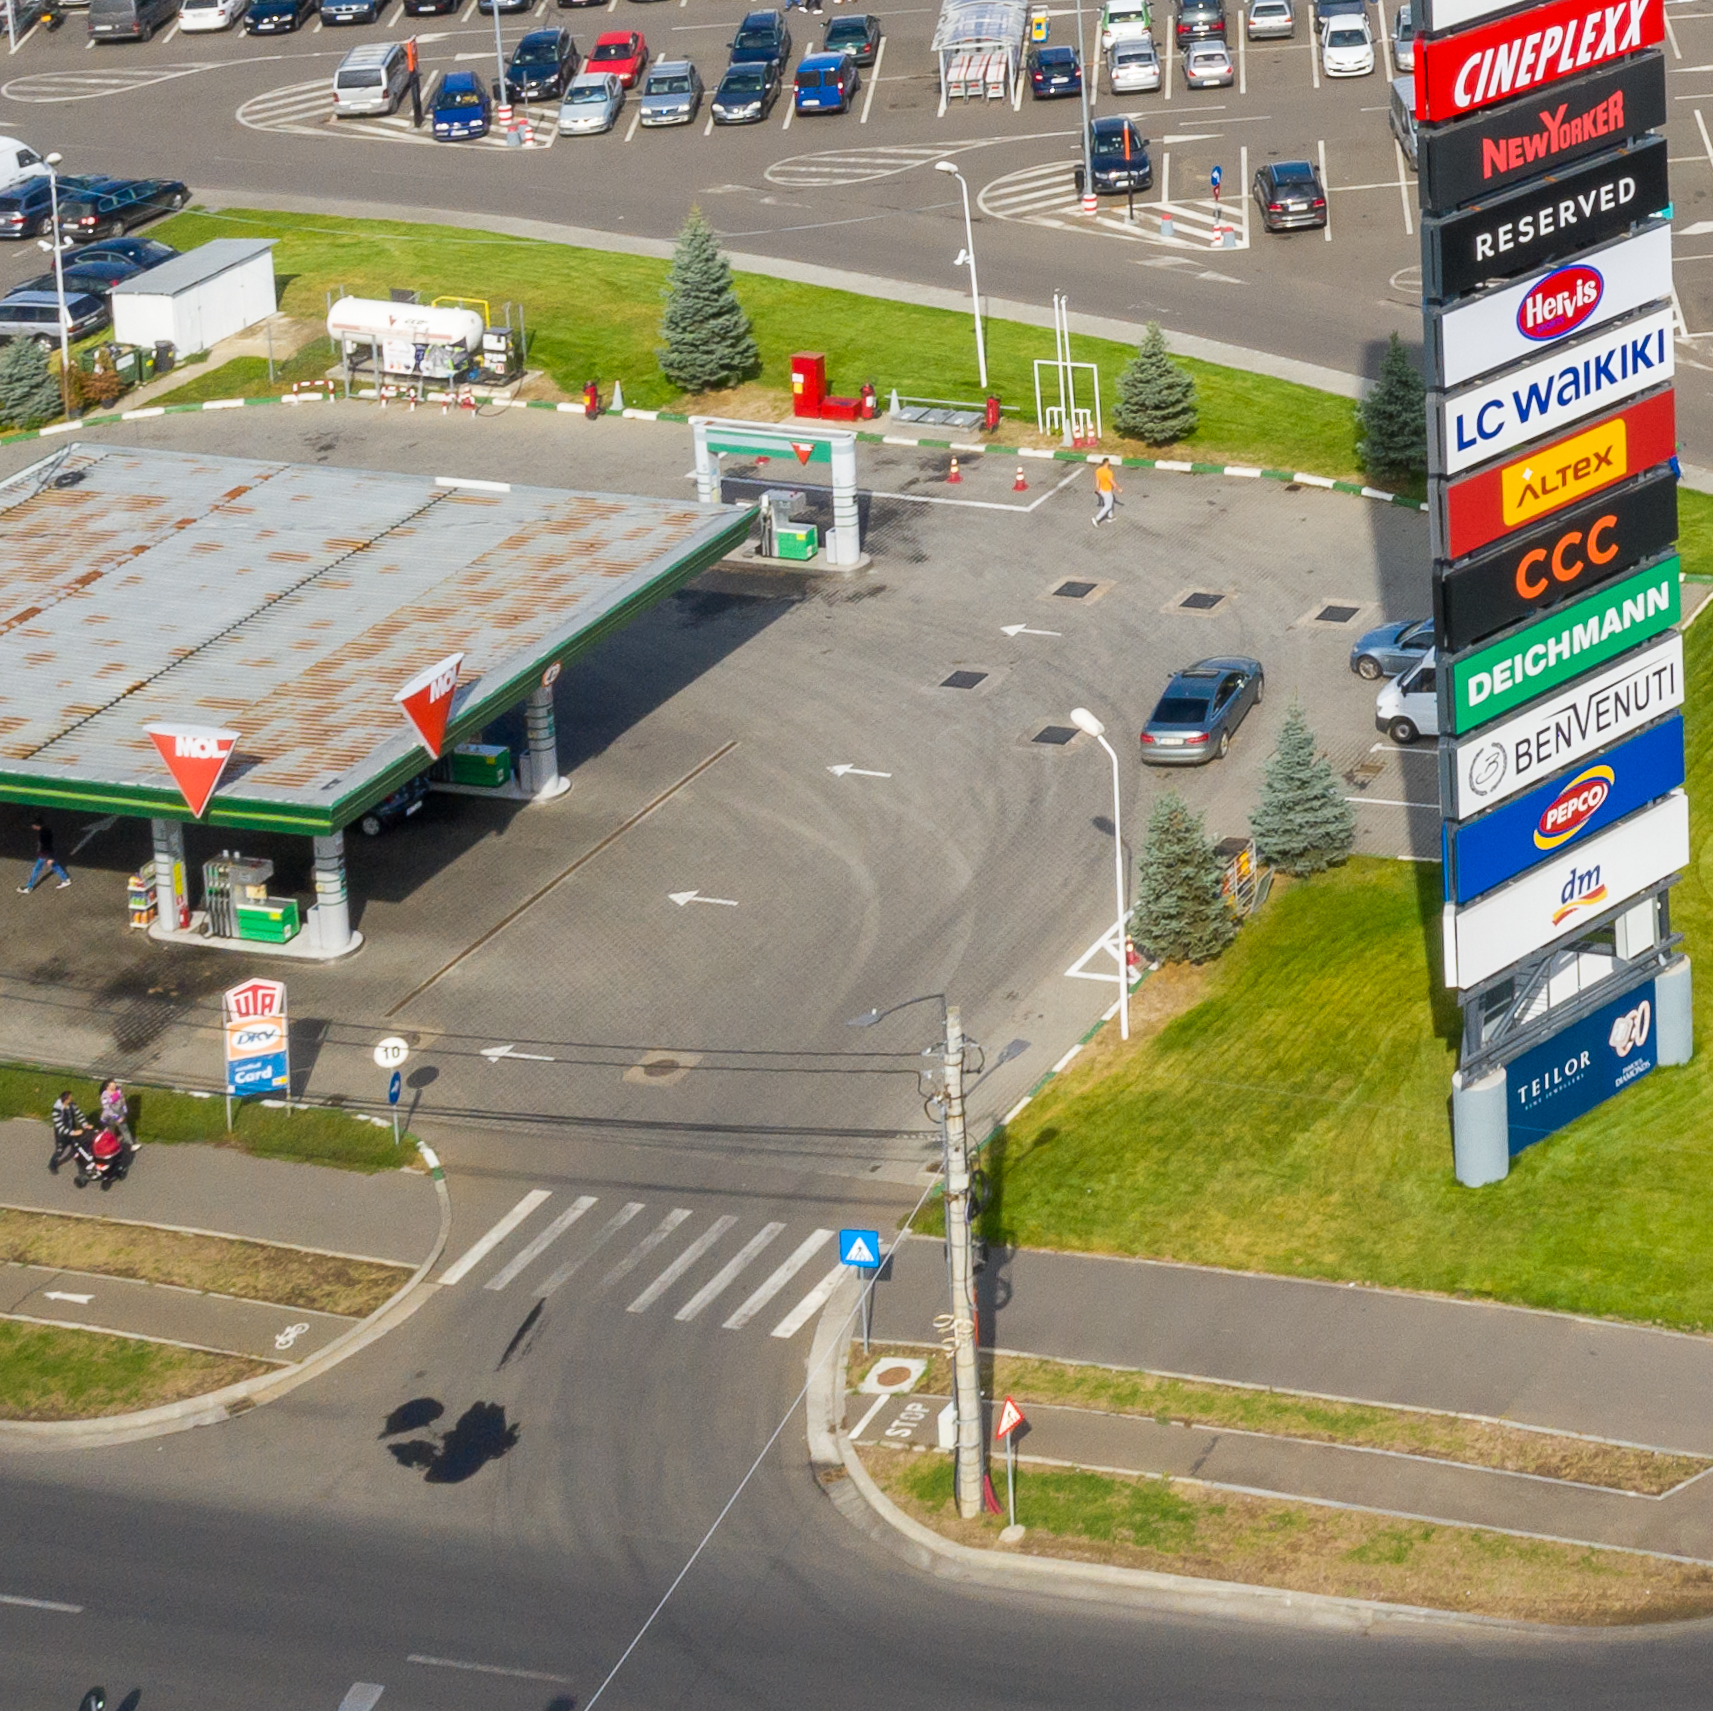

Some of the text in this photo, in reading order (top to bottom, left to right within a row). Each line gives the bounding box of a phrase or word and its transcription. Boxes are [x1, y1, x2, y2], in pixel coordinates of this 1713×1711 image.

[1476, 176, 1636, 262] RESERVED
[1525, 278, 1599, 331] Hervis
[1456, 399, 1506, 452] LC
[1515, 514, 1619, 599] CCC
[1468, 581, 1670, 707] DEICHMANN
[1514, 658, 1675, 776] BENVENUTI
[175, 735, 229, 759] MOL
[1546, 786, 1602, 830] PEPCO
[1561, 863, 1601, 906] dm
[233, 984, 277, 1018] UTA
[237, 1029, 276, 1045] DKV
[383, 1046, 400, 1060] 10
[234, 1065, 273, 1084] Card
[1517, 1050, 1591, 1104] TEILOR
[885, 1401, 931, 1438] STOP
